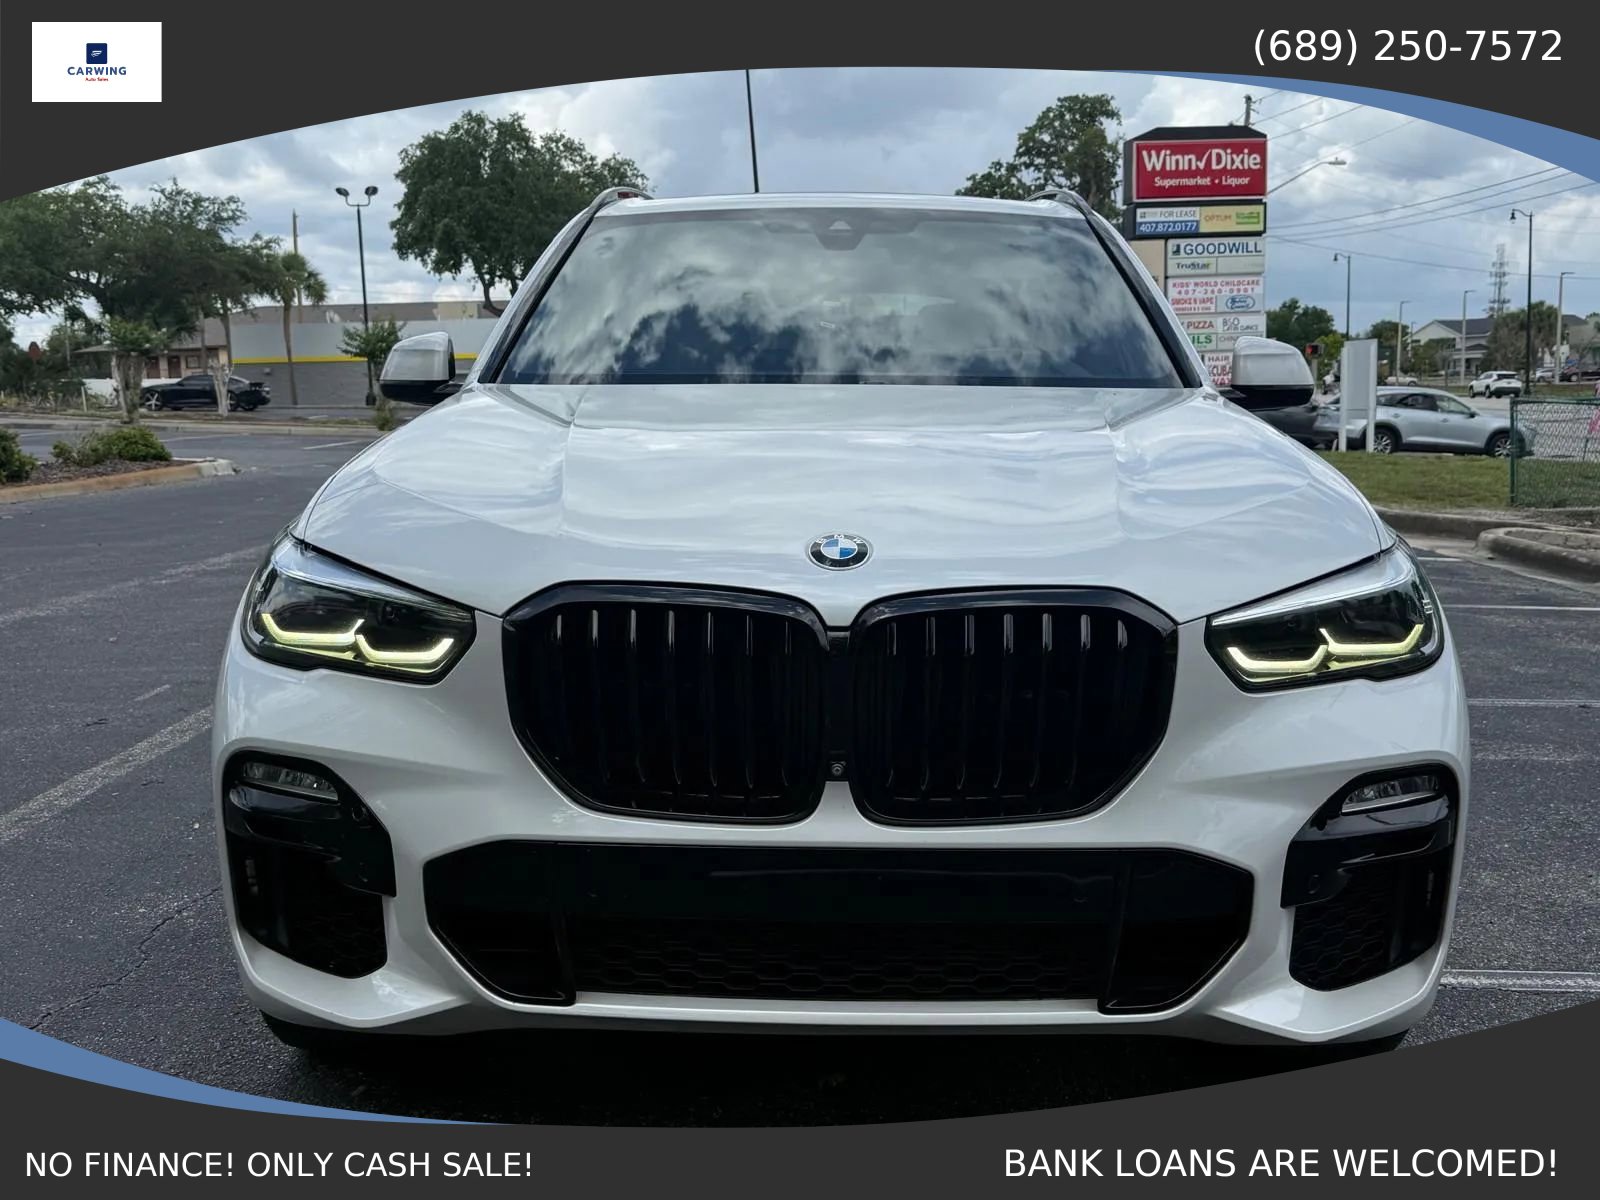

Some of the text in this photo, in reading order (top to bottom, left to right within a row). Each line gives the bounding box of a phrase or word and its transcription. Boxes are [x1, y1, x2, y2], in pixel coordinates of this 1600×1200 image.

[1142, 148, 1261, 172] Winn Dixie
[1154, 175, 1251, 189] Supermarket Liquor
[1159, 210, 1175, 219] FOR
[1175, 209, 1197, 218] LEASE
[1139, 222, 1197, 233] 407.872.0177
[1183, 242, 1262, 255] GOODWILL
[1193, 280, 1218, 288] WORLD
[1220, 279, 1260, 288] CHILDCARE
[1187, 320, 1215, 330] PIZZA
[1191, 334, 1212, 345] ILS
